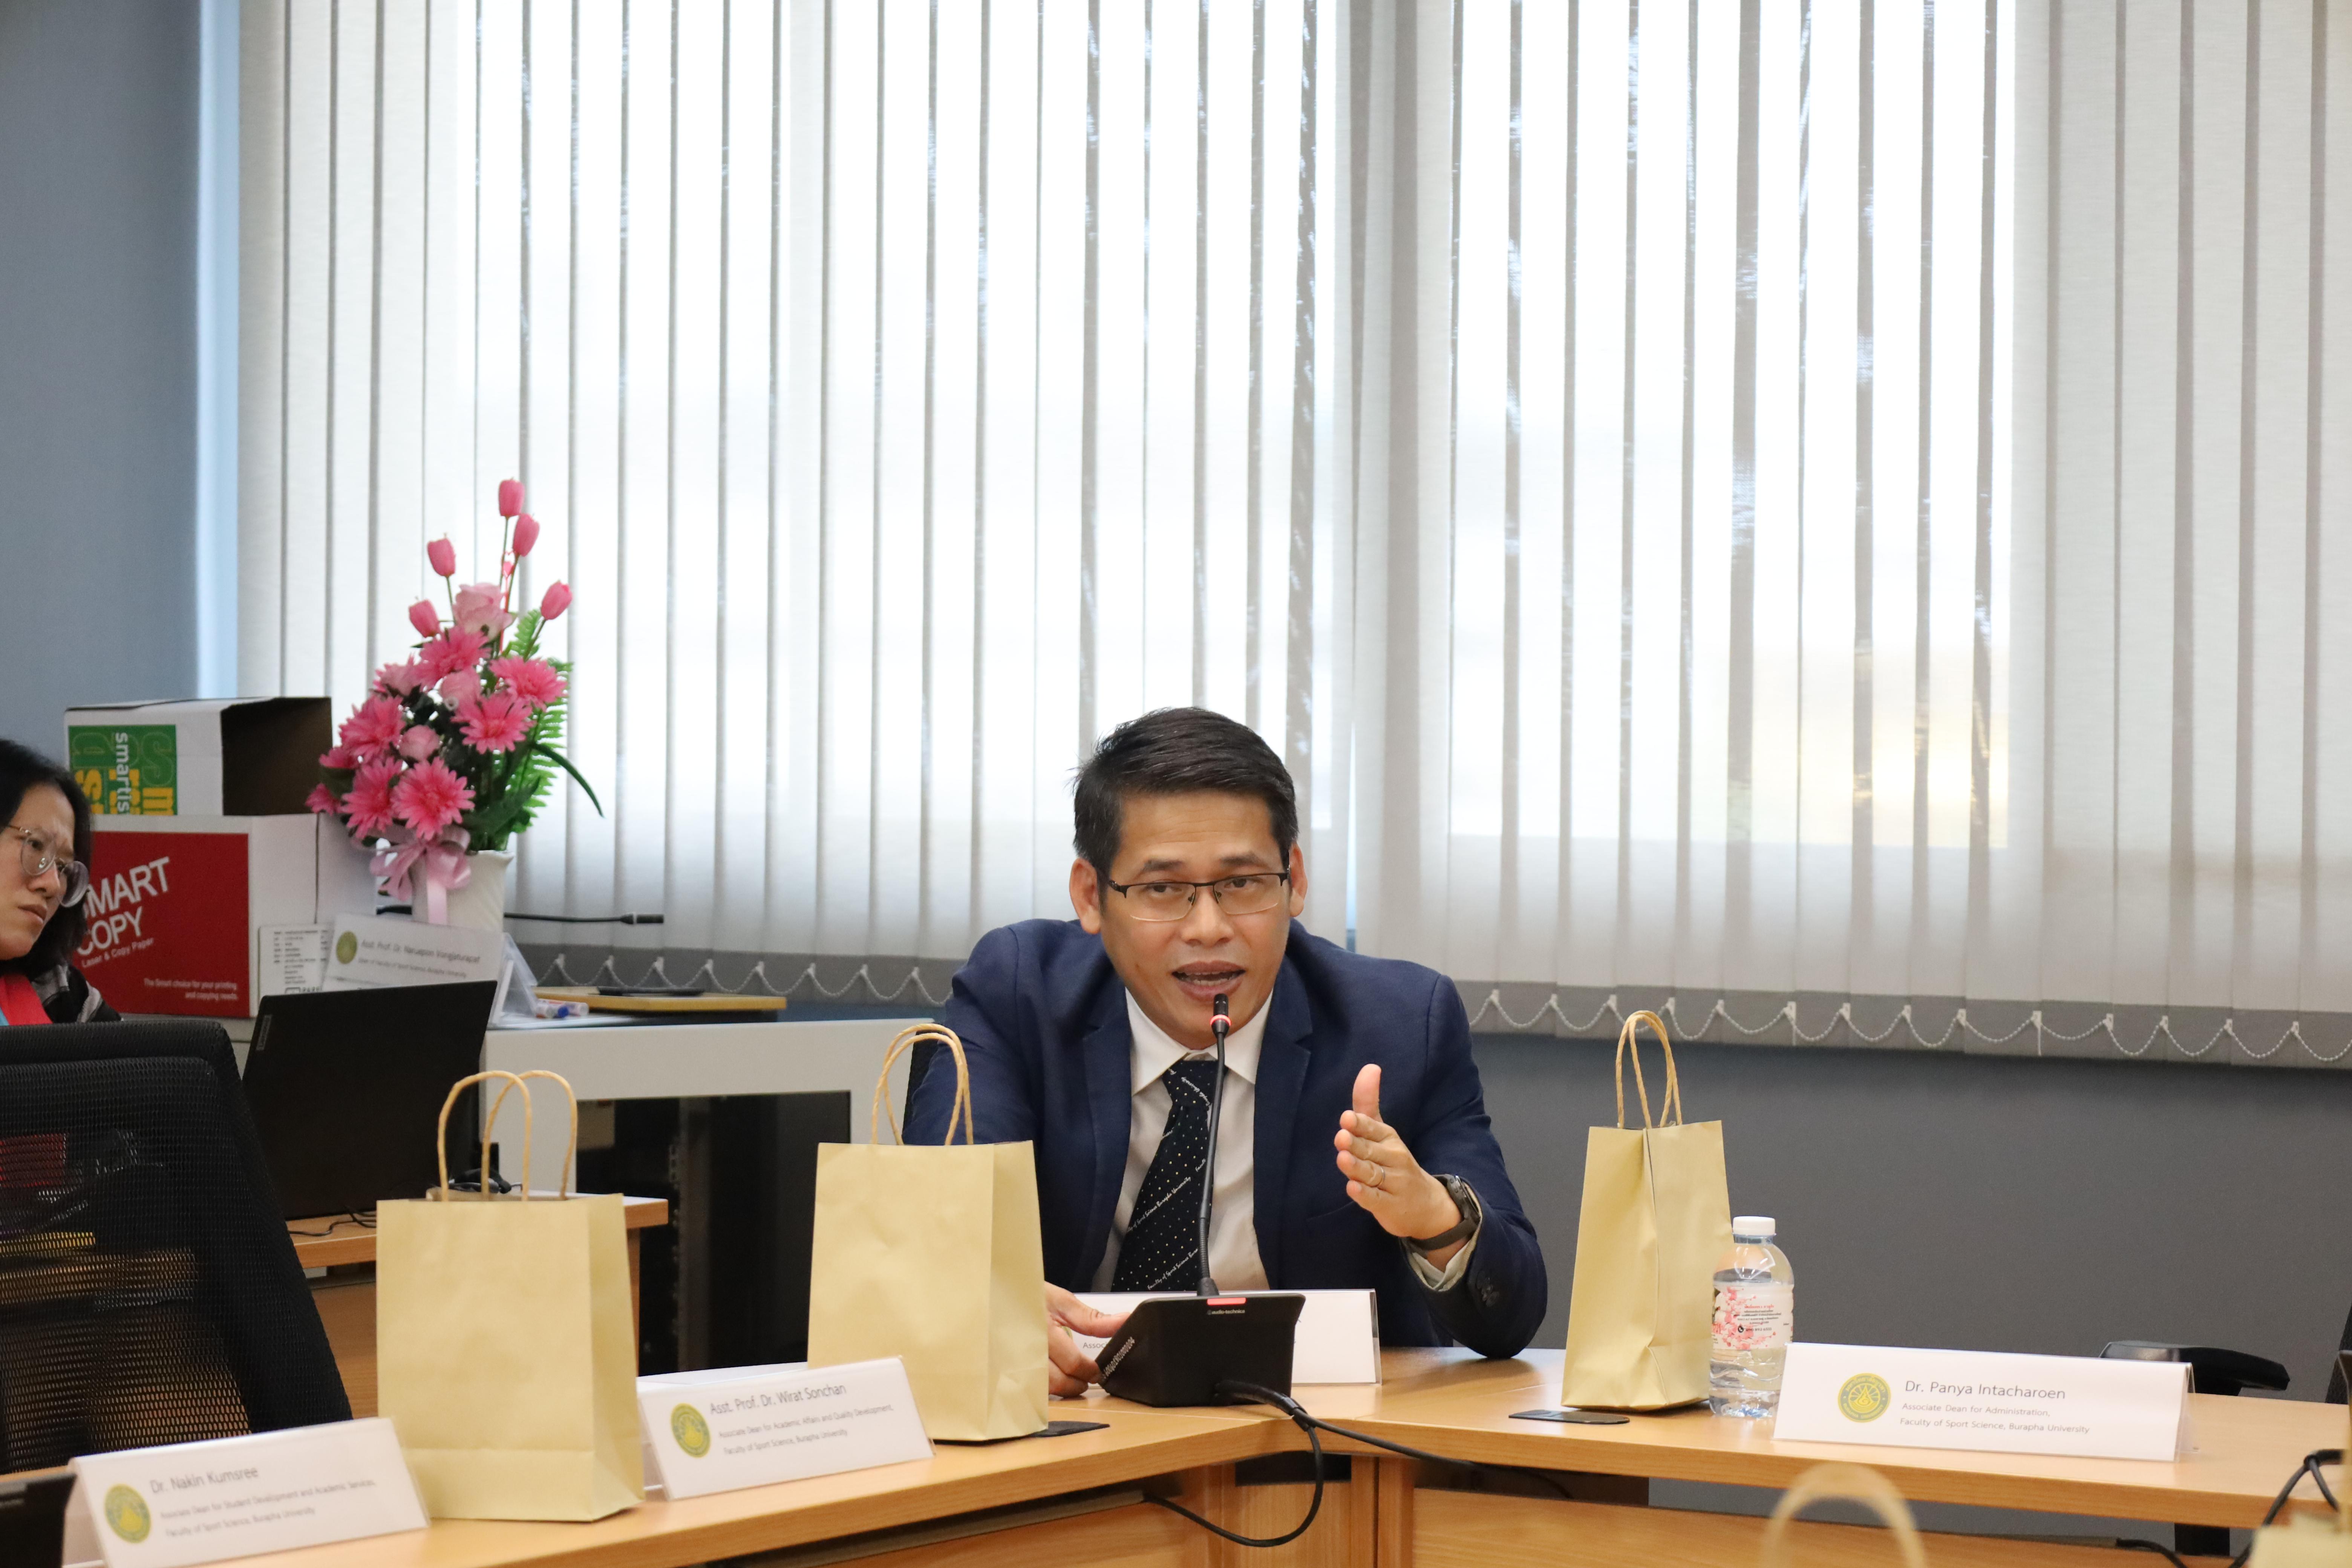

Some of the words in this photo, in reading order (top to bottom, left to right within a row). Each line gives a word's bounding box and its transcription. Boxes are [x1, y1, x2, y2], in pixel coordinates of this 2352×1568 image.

[115, 732, 132, 815] smartis
[111, 946, 131, 958] Copy
[132, 937, 154, 952] Paper
[1156, 1193, 1172, 1207] Burapha
[1171, 1176, 1191, 1194] University
[1147, 1279, 1162, 1290] Faculty
[1165, 1266, 1177, 1277] Sport
[1176, 1256, 1189, 1269] Science
[1188, 1248, 1199, 1258] Bura
[710, 1401, 733, 1415] Asst.
[735, 1395, 760, 1411] Prof.
[760, 1394, 776, 1407] Dr.
[776, 1390, 804, 1404] Wirat
[804, 1384, 847, 1400] Sonchan
[1905, 1380, 1924, 1392] Dr.
[1930, 1381, 1973, 1396] Panya
[1978, 1384, 2066, 1399] Intacharoen
[833, 1411, 854, 1420] Quality
[1902, 1403, 1942, 1411] Associate
[1985, 1406, 2050, 1417] Administration,
[1900, 1418, 1931, 1427] Faculty
[1946, 1420, 1969, 1429] Sport
[1972, 1421, 2006, 1430] Science,
[2009, 1423, 2044, 1432] Burapha
[2047, 1424, 2090, 1435] University
[723, 1446, 746, 1455] Faculty
[754, 1442, 771, 1450] Sport
[821, 1429, 848, 1439] University
[150, 1478, 168, 1494] Dr.
[170, 1473, 205, 1490] Nakin
[206, 1467, 259, 1484] Kumsree
